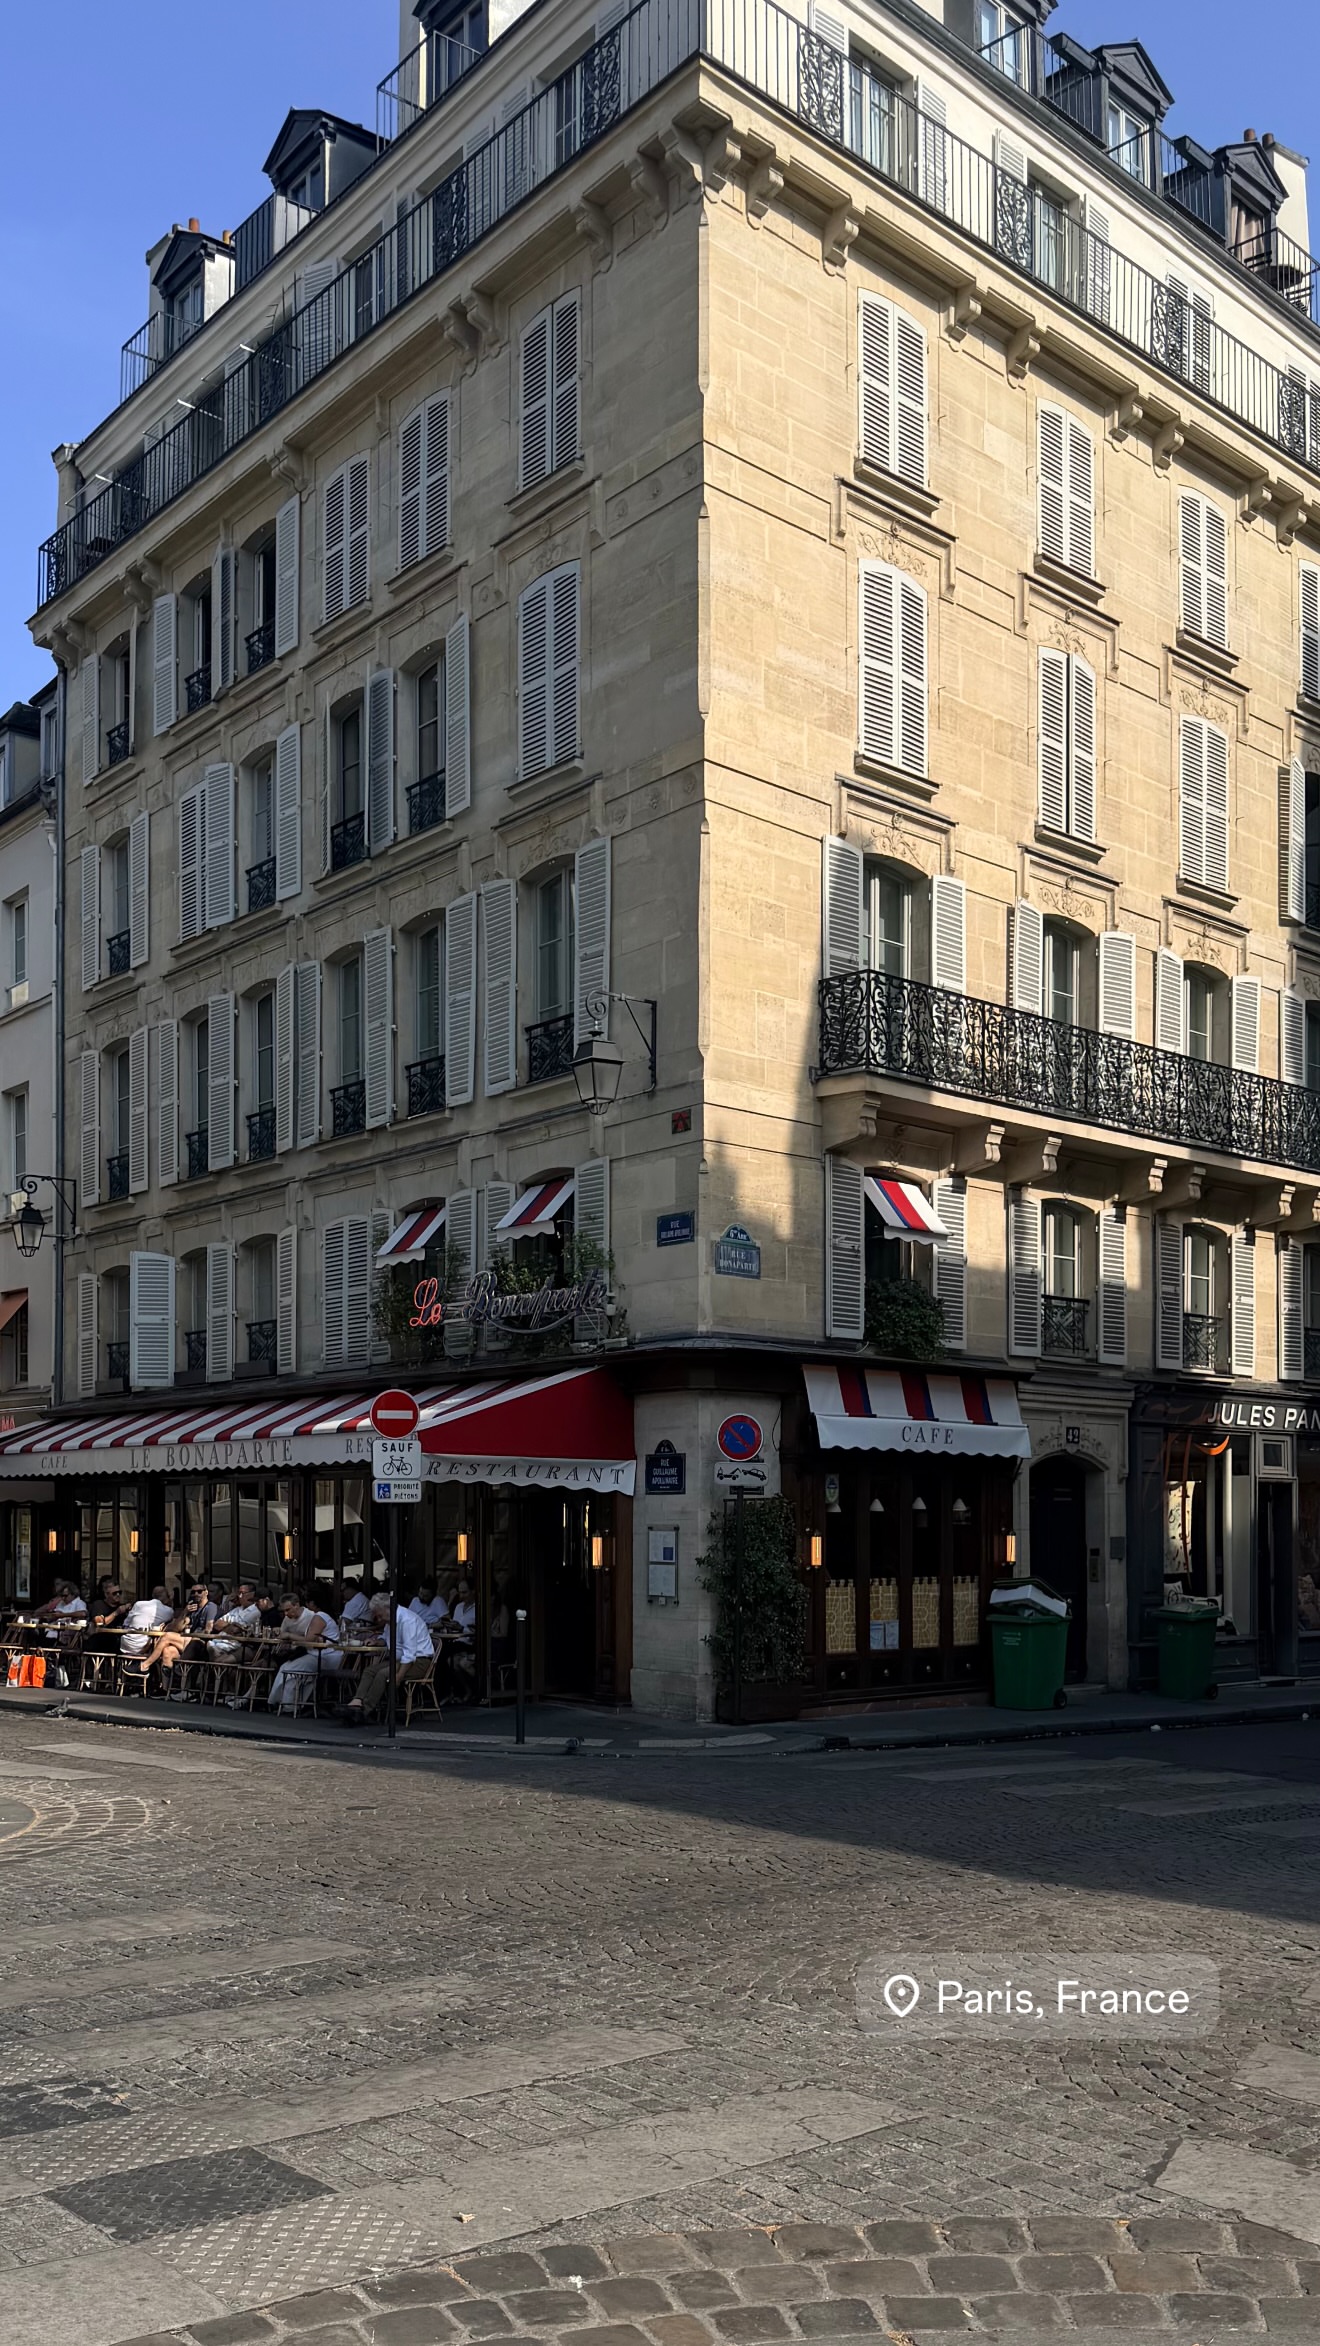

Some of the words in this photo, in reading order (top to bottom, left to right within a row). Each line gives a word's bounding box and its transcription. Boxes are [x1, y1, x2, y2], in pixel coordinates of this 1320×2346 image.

[731, 1249, 746, 1260] RUE
[409, 1277, 443, 1327] Le
[1207, 1402, 1276, 1428] JULES
[902, 1425, 954, 1445] CAFE
[1067, 1428, 1079, 1442] 42
[41, 1455, 68, 1469] CAFE
[130, 1447, 150, 1469] LE
[165, 1439, 293, 1467] BONAPARTE
[381, 1442, 414, 1453] SAUF
[425, 1460, 625, 1485] RESTAURANT
[393, 1482, 419, 1490] PRIORITÉ
[394, 1491, 419, 1500] PIÉTONS
